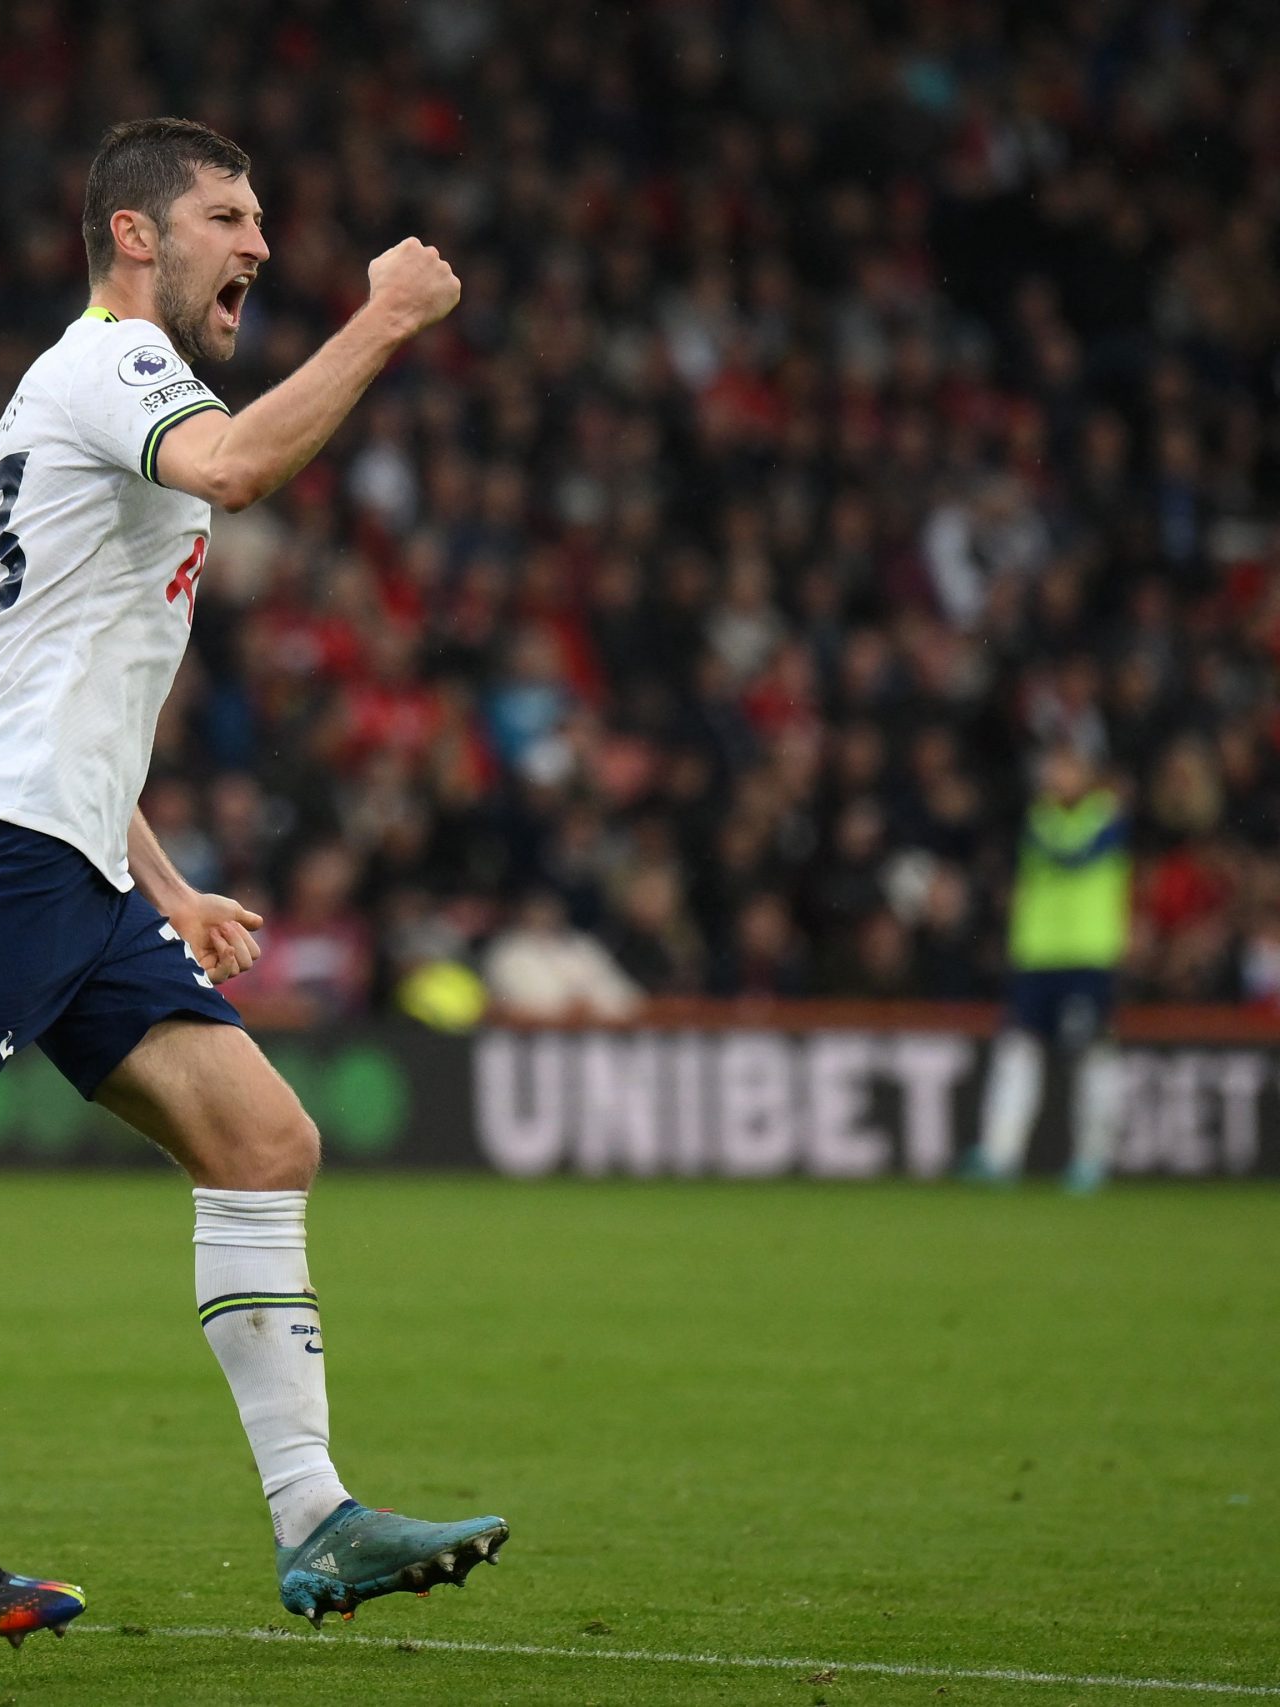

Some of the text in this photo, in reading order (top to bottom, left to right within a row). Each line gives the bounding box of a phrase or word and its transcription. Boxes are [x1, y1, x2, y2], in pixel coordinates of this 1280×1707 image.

[140, 382, 199, 410] No room
[473, 1033, 976, 1176] UNIBET
[291, 1324, 322, 1336] SP
[311, 1562, 340, 1574] adidas
